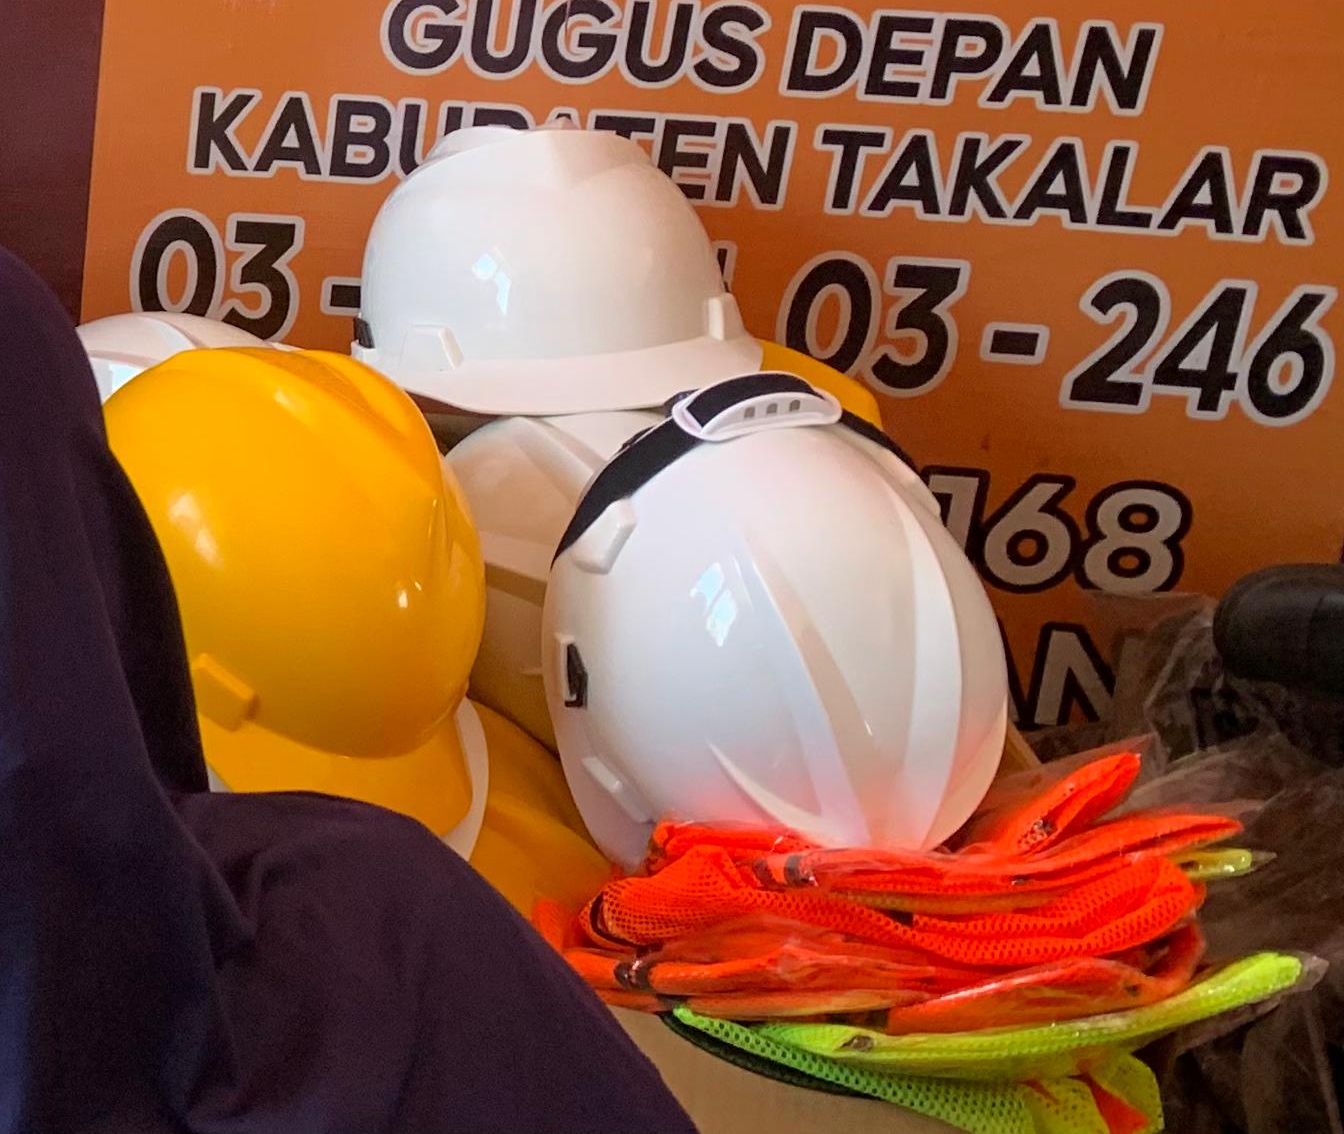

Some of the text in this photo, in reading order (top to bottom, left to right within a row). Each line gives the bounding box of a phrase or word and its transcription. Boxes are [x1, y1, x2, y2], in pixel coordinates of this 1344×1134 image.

[779, 5, 1165, 118] DEPAN
[817, 128, 1328, 245] TAKALAR
[131, 208, 305, 343] 03
[777, 250, 971, 398] 03
[1059, 268, 1337, 426] 246
